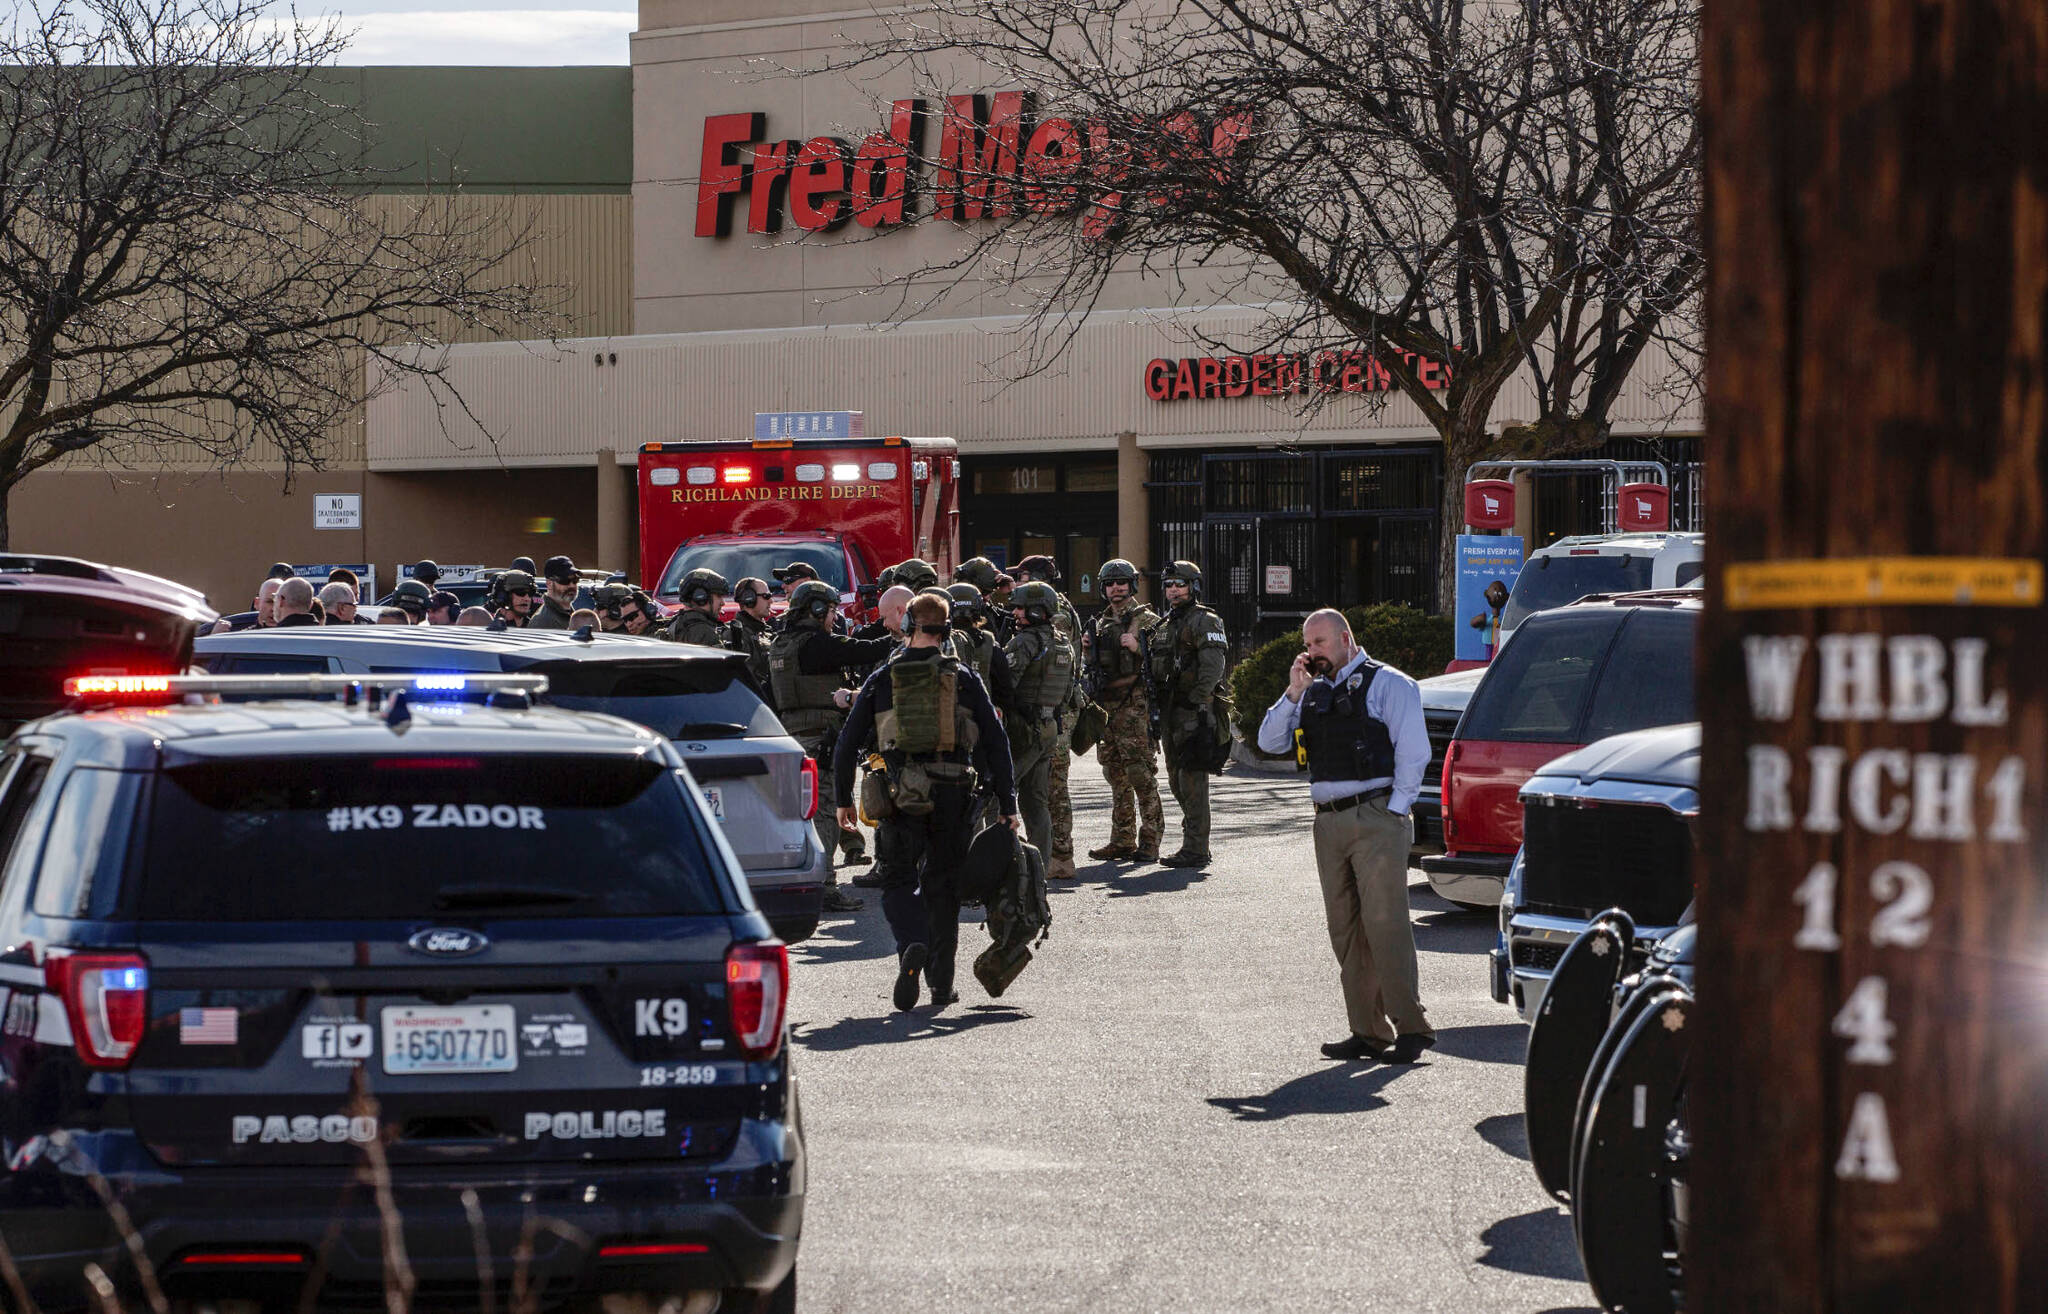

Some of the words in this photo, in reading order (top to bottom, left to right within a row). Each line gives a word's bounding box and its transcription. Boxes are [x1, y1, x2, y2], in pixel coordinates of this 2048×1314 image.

[695, 98, 916, 238] Fred
[1145, 353, 1302, 401] GARDEN
[1314, 346, 1460, 394] CENE
[671, 487, 772, 502] RICHLAND
[778, 486, 823, 500] FIRE
[830, 485, 883, 499] DEPT.
[1013, 467, 1038, 489] 101
[331, 498, 343, 509] NO
[1463, 547, 1486, 555] FRESH
[1487, 547, 1507, 555] EVERY
[1744, 633, 2009, 727] WHBL
[327, 805, 403, 831] #K9
[412, 804, 546, 830] ZADOR
[426, 932, 472, 952] Ford
[635, 998, 688, 1036] K9
[1831, 975, 1897, 1065] 4
[640, 1066, 717, 1086] 18-259
[233, 1115, 378, 1144] PASCO
[525, 1109, 667, 1140] POLICE
[1834, 1091, 1900, 1184] A
